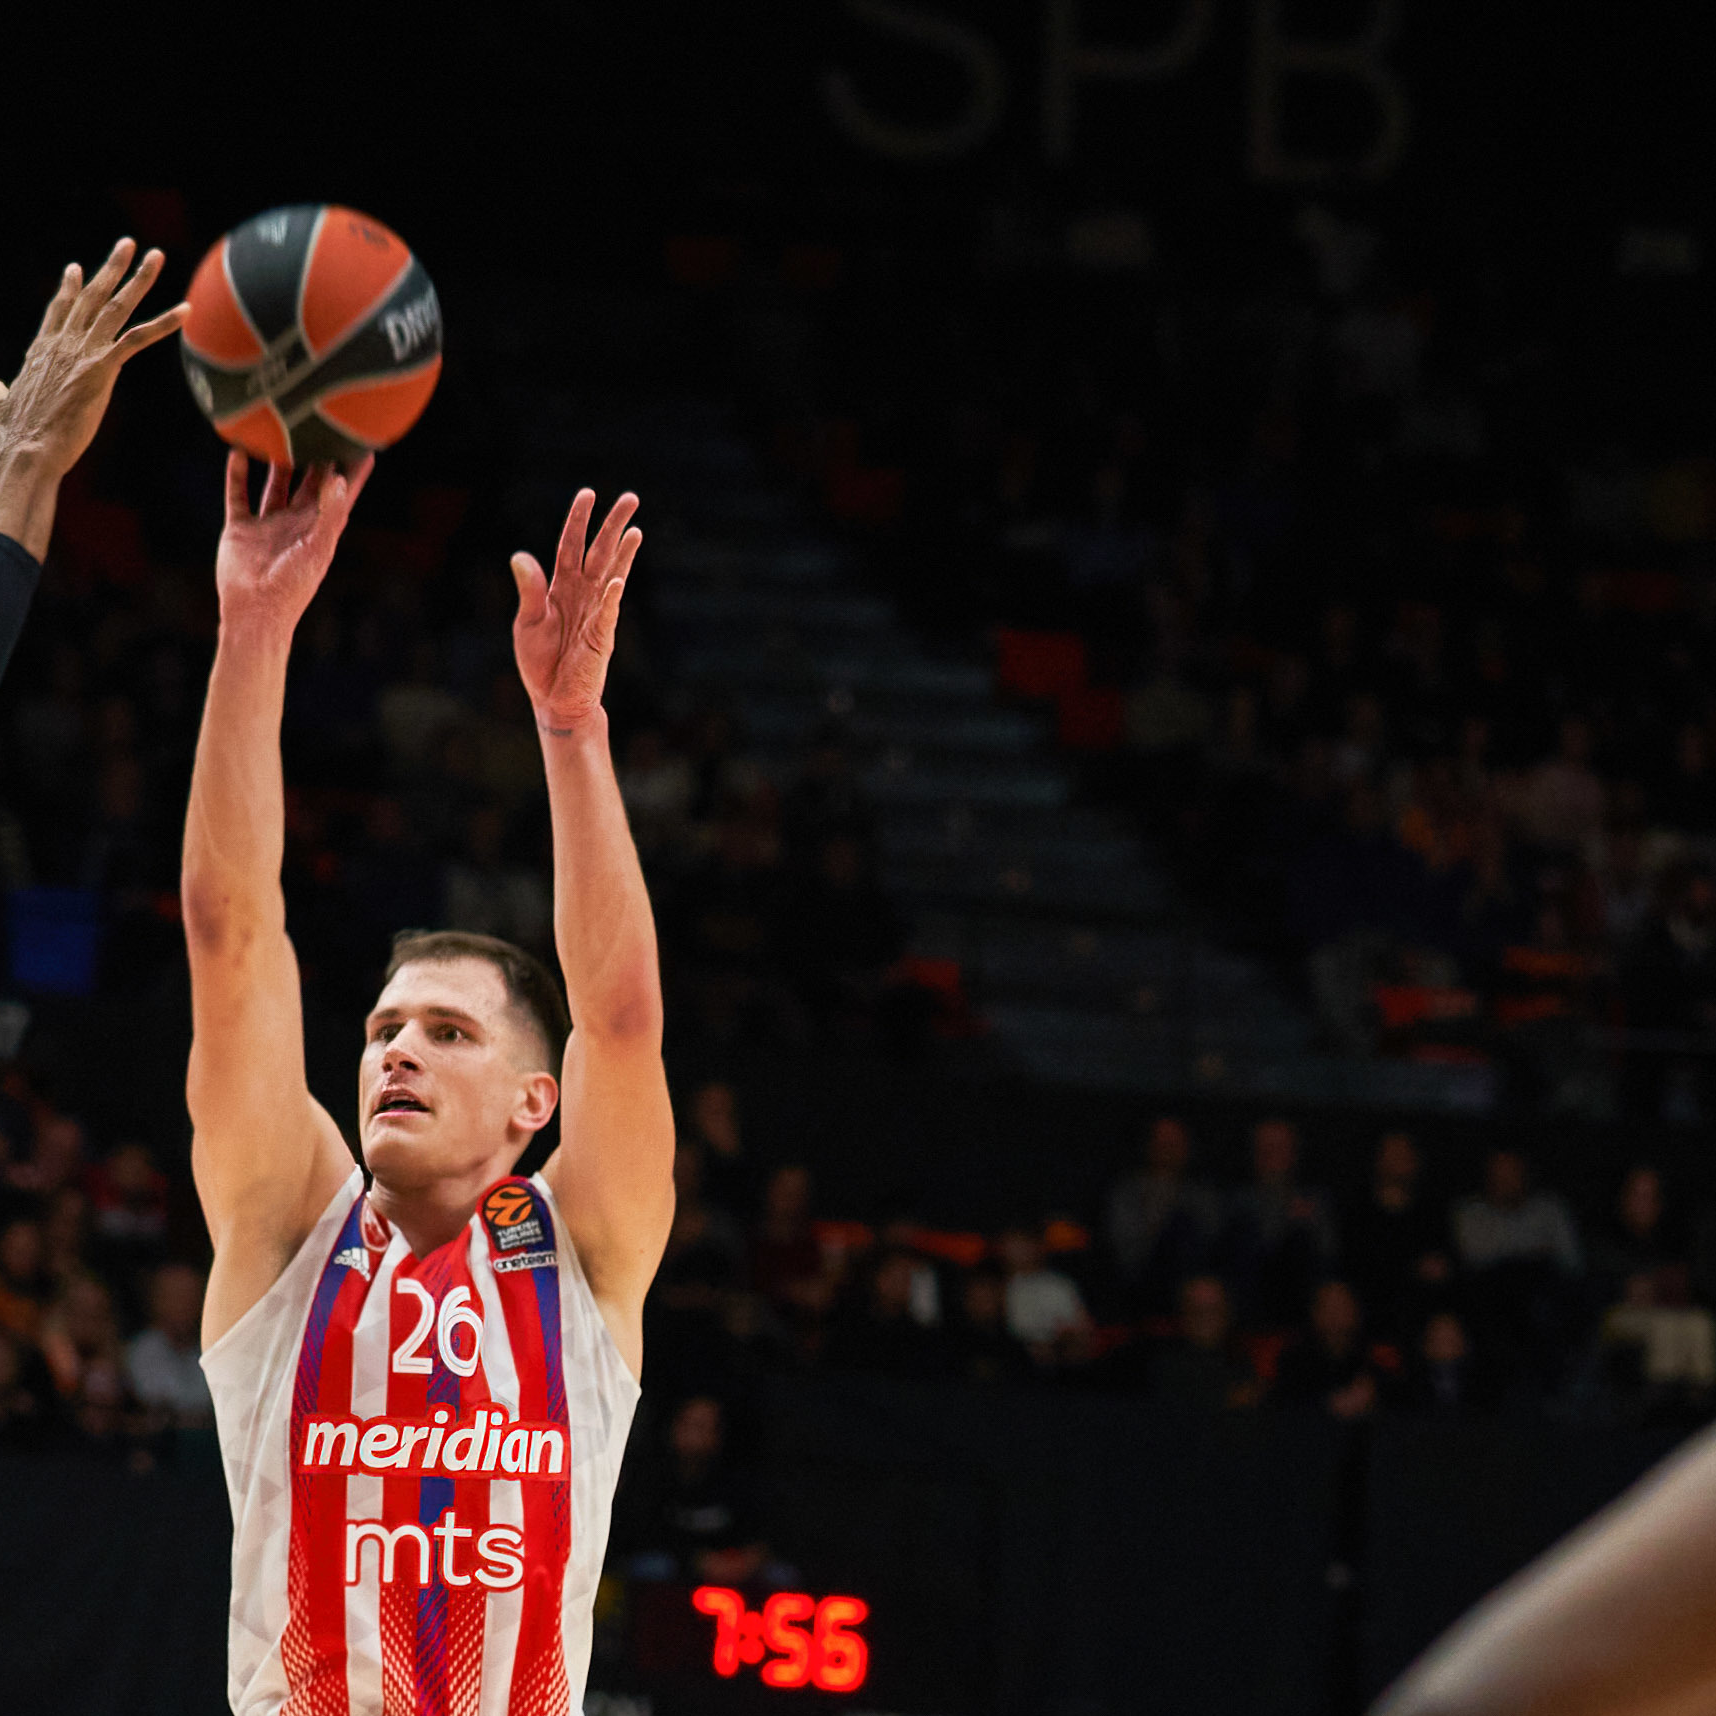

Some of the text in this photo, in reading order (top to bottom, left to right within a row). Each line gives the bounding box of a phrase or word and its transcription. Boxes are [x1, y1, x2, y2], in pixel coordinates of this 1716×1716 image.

[391, 1277, 485, 1377] 26
[303, 1410, 564, 1474] meridian
[344, 1512, 525, 1588] mts
[692, 1586, 870, 1693] 7:56
